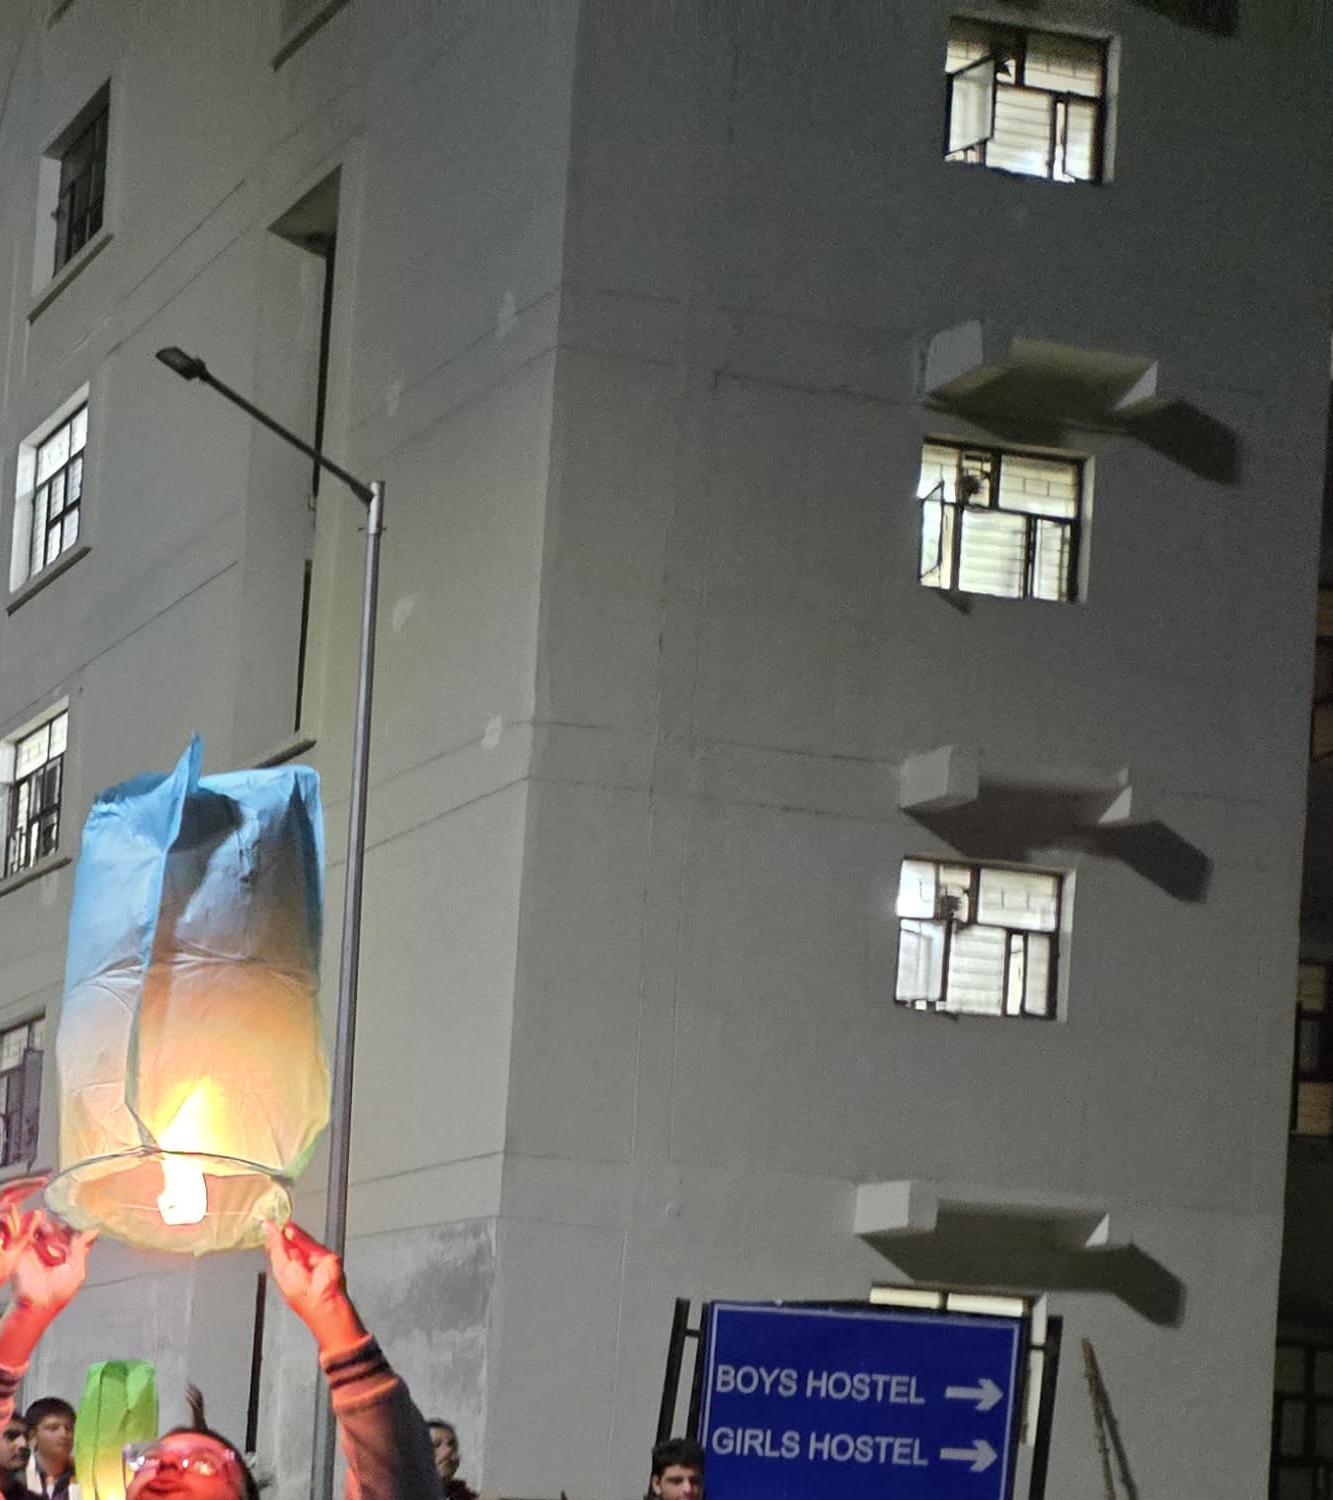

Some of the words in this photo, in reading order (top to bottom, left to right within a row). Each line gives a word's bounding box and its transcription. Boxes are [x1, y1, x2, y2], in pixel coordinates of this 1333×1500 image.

[716, 1364, 797, 1397] BOYS
[806, 1370, 925, 1404] HOSTEL
[712, 1427, 799, 1459] GIRLS
[808, 1433, 927, 1466] HOSTEL
